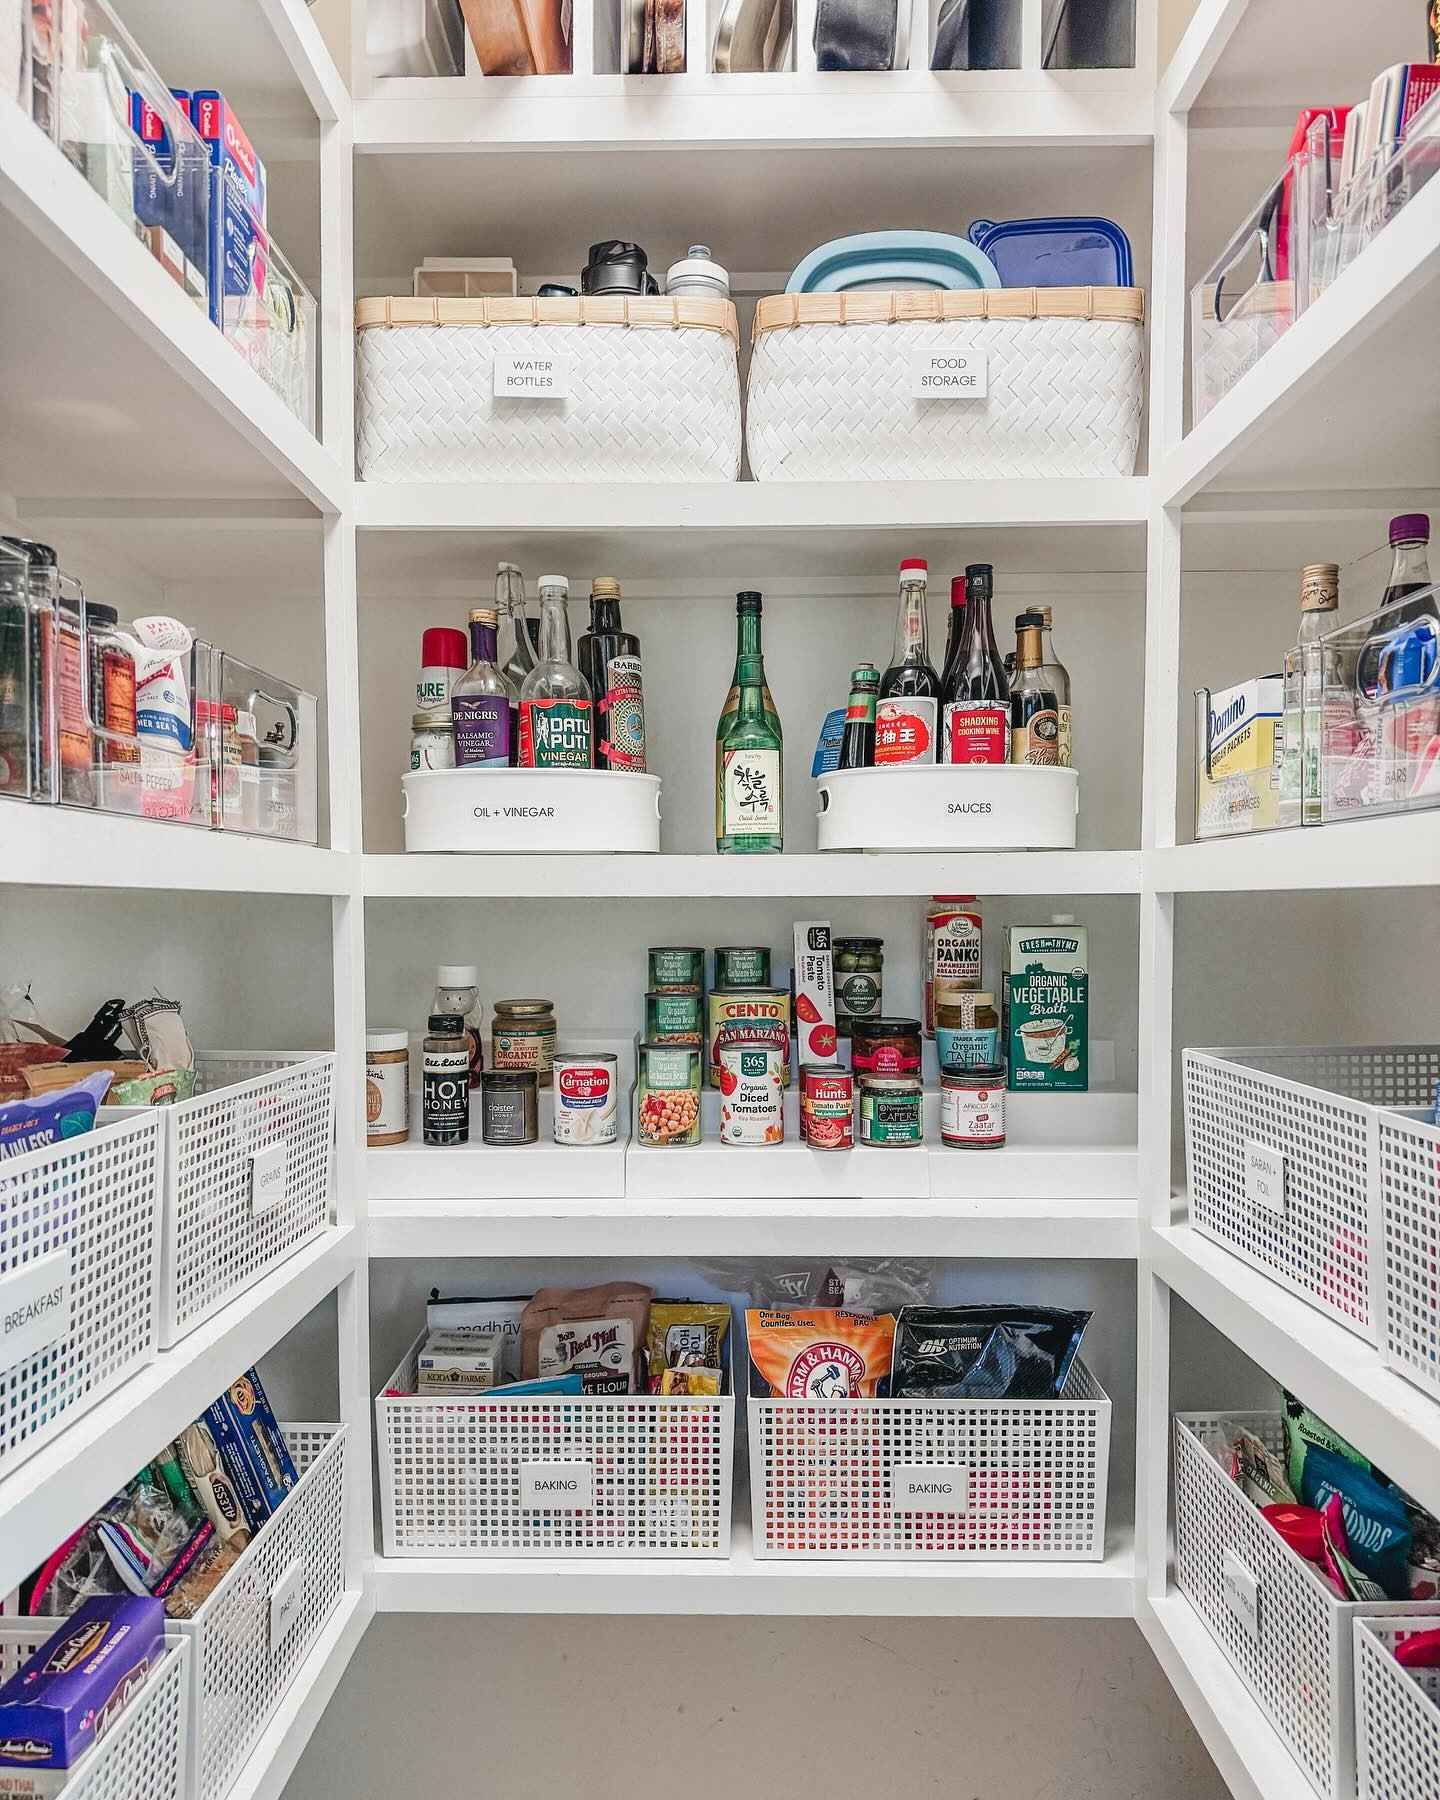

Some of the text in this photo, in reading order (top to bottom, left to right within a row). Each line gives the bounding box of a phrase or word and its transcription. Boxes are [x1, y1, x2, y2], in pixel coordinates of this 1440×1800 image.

[513, 361, 553, 372] WATER
[931, 358, 967, 369] FOOD
[506, 376, 553, 387] BOTTLES
[921, 375, 977, 387] STORAGE
[417, 683, 445, 697] PURE
[453, 711, 498, 720] DE NIGRIS
[1210, 695, 1245, 742] Domino
[550, 718, 590, 734] DATU
[960, 717, 999, 727] SHAOXING
[958, 727, 1000, 736] COOKING WINE
[551, 734, 586, 749] PUTI
[1227, 727, 1251, 754] PACKETS
[540, 752, 588, 762] VINEGAR
[119, 767, 138, 784] SALT
[146, 774, 173, 793] PEPPER
[1385, 768, 1407, 786] BARS
[473, 806, 554, 818] OIL + VINEGAR
[947, 803, 992, 815] SAUCES
[815, 928, 827, 948] 365
[937, 938, 979, 948] ORGANIC
[1021, 940, 1077, 951] FRESH THYME
[937, 948, 979, 961] PANKO
[806, 955, 815, 981] Paste
[816, 955, 825, 991] Tomato
[1029, 975, 1068, 987] ORGANIC
[1013, 987, 1085, 1004] VEGETABLE
[726, 1004, 779, 1018] CENTO
[1029, 1003, 1069, 1015] Broth
[720, 1029, 786, 1043] SAN MARZANO
[951, 1042, 988, 1052] Organic
[497, 1050, 538, 1060] ORGANIC
[946, 1051, 990, 1064] TAHINI
[425, 1056, 467, 1067] Bee Local
[743, 1055, 765, 1068] 365
[561, 1073, 608, 1089] Carnation
[425, 1081, 468, 1100] HOT
[741, 1083, 768, 1093] Organic
[815, 1088, 847, 1098] Hunt's
[740, 1092, 769, 1102] Diced
[425, 1099, 468, 1110] HONEY
[731, 1103, 777, 1114] Tomatoes
[811, 1101, 834, 1109] Tomato
[879, 1112, 918, 1121] CAPERS
[968, 1120, 995, 1129] Zaatar
[5, 1286, 64, 1334] BREAKFAST
[760, 1320, 795, 1328] Countless
[569, 1327, 617, 1361] Red Mill
[948, 1336, 978, 1344] OPTIMUM
[948, 1343, 982, 1351] NUTRITION
[793, 1361, 810, 1398] ARM
[597, 1381, 627, 1394] FLOUR
[1298, 1422, 1325, 1447] Roasted
[250, 1435, 274, 1489] SPAGHETTI
[534, 1480, 577, 1491] BAKING
[1246, 1466, 1276, 1496] ORGANIC
[908, 1483, 952, 1494] BAKING
[212, 1482, 236, 1518] ALESSI
